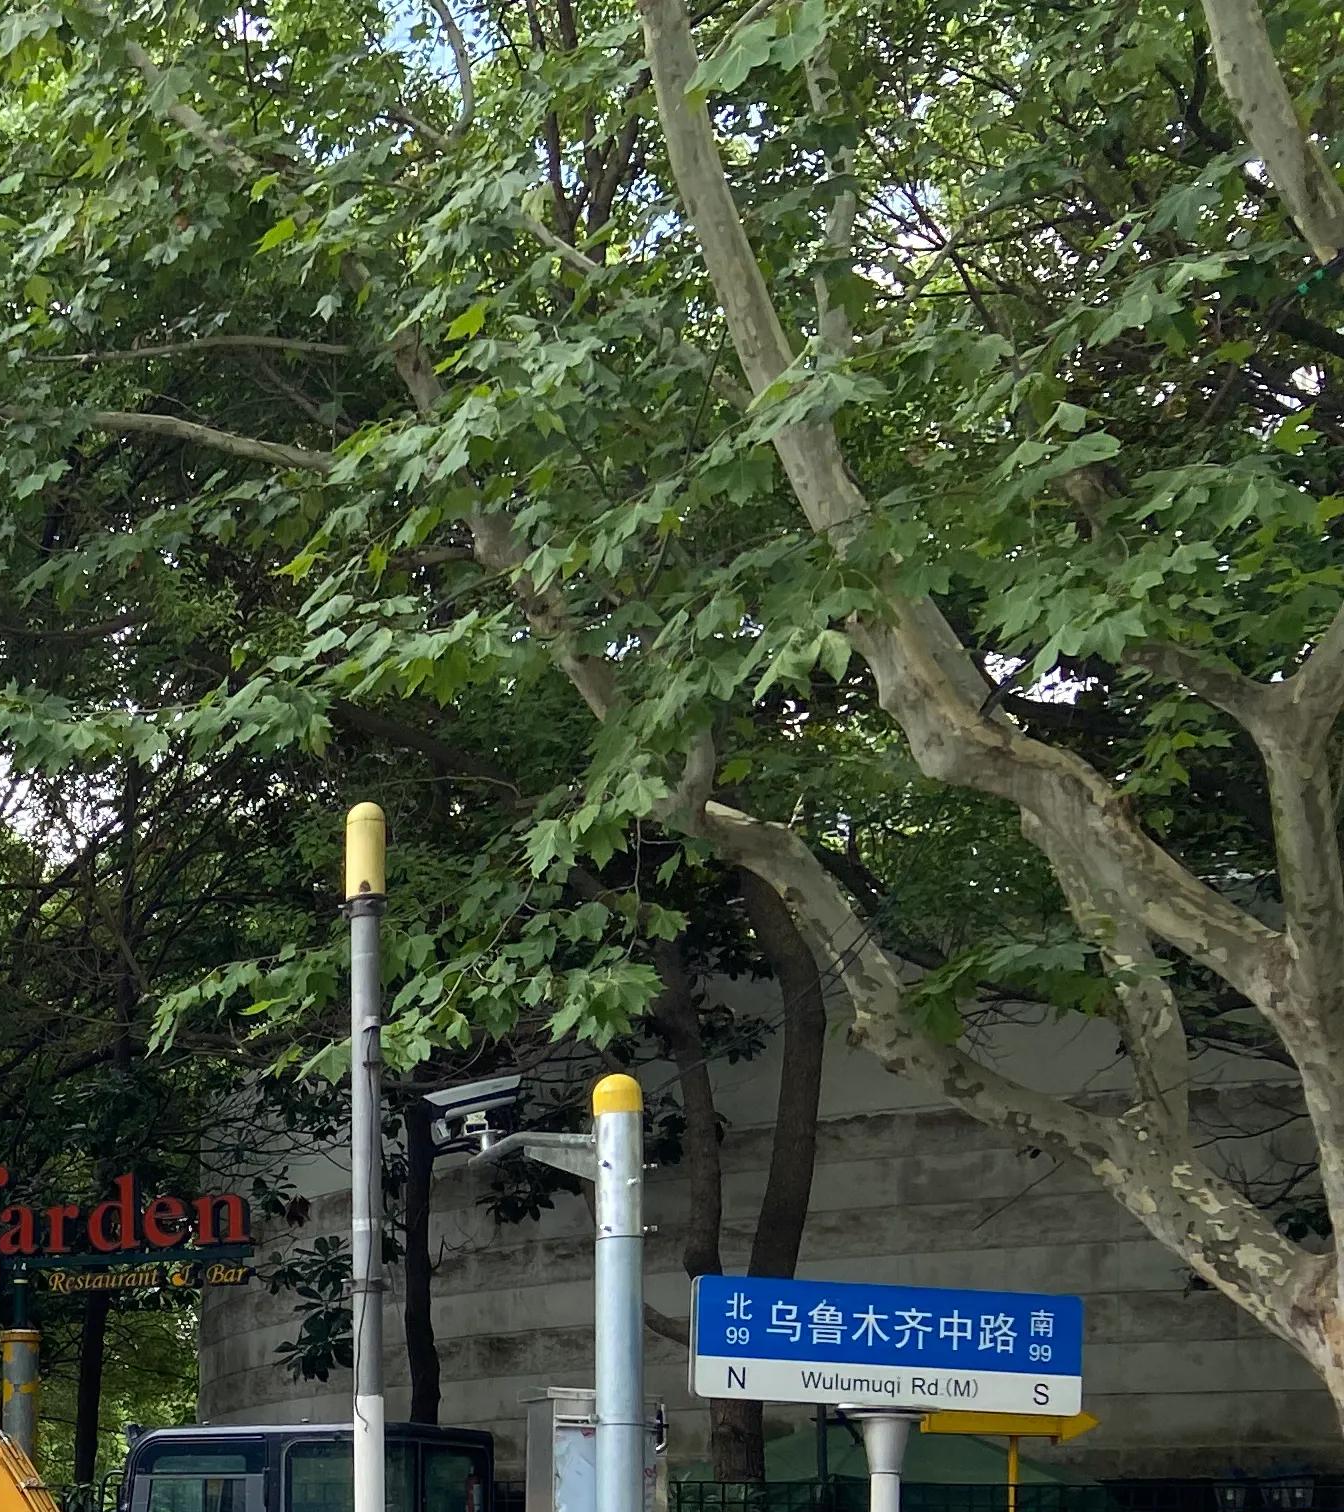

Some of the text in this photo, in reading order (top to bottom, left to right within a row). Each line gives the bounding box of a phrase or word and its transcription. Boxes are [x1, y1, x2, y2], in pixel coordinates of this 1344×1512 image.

[49, 1268, 160, 1294] Restaurant
[206, 1263, 250, 1287] Bar
[725, 1292, 752, 1320] 北
[726, 1326, 750, 1345] 99
[765, 1298, 1018, 1354] 乌鲁木齐中路
[1030, 1309, 1055, 1338] 南
[1028, 1343, 1052, 1362] 99
[727, 1366, 746, 1389] N
[801, 1370, 901, 1397] Wulumuqi
[1033, 1383, 1050, 1406] S
